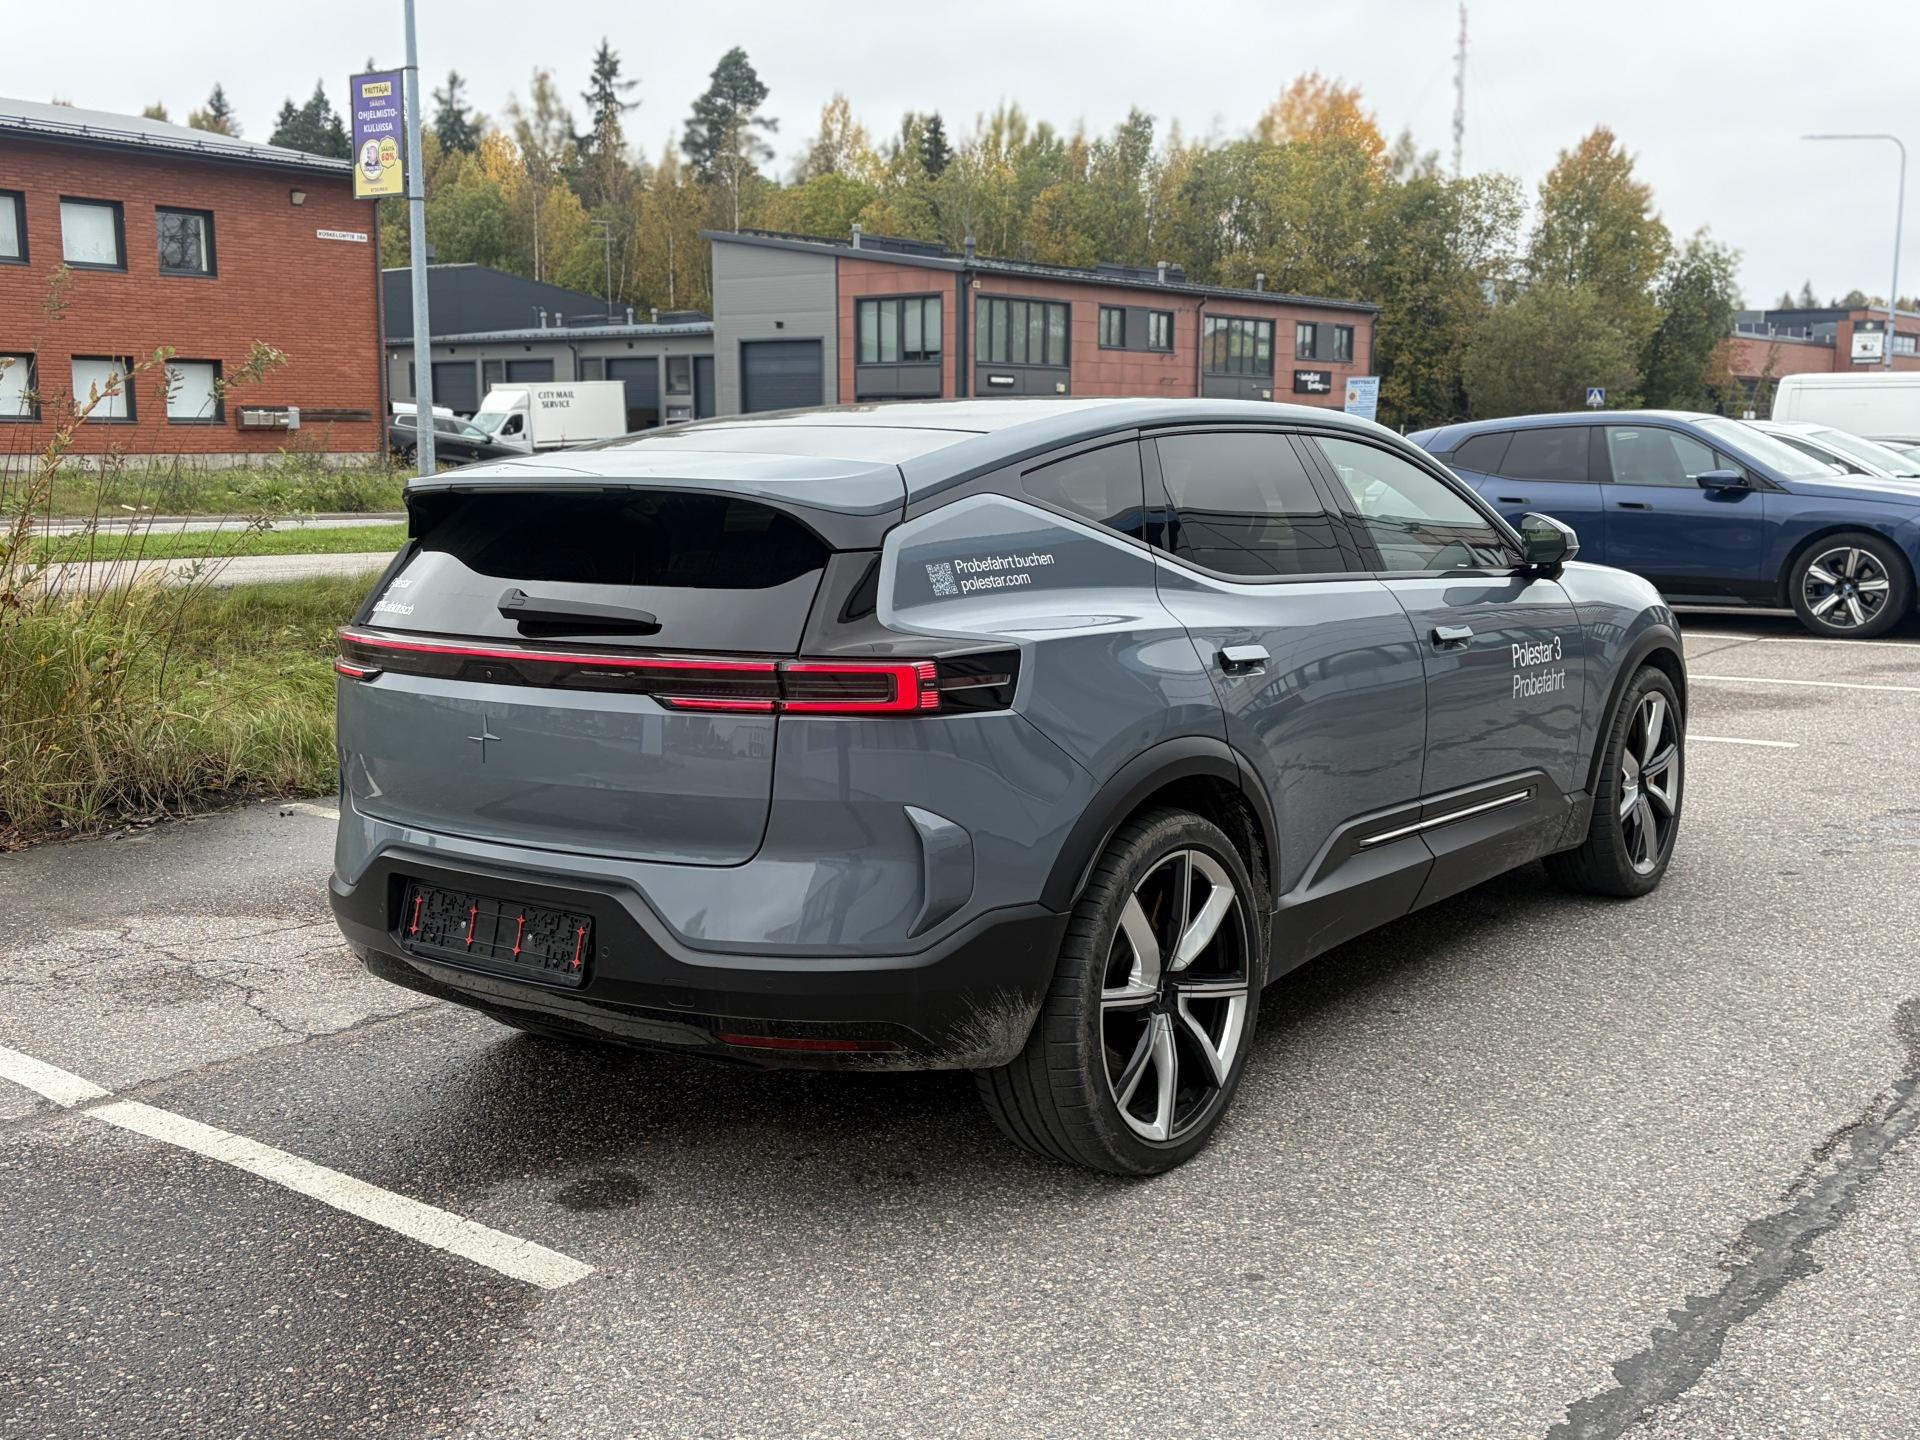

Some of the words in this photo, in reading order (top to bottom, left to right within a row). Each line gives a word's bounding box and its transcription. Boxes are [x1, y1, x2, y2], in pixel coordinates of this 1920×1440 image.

[357, 108, 398, 121] OHJELMISTO-
[363, 122, 393, 133] KULUISSA
[538, 391, 555, 399] CITY
[555, 391, 575, 399] MAIL
[541, 400, 571, 409] SERVICE
[954, 555, 1015, 574] Probefahrt
[1013, 552, 1055, 568] buchen
[960, 573, 1031, 595] polestar.com
[1511, 641, 1553, 669] Polestar
[1554, 636, 1562, 660] 3
[1512, 667, 1566, 700] Probefahrt
